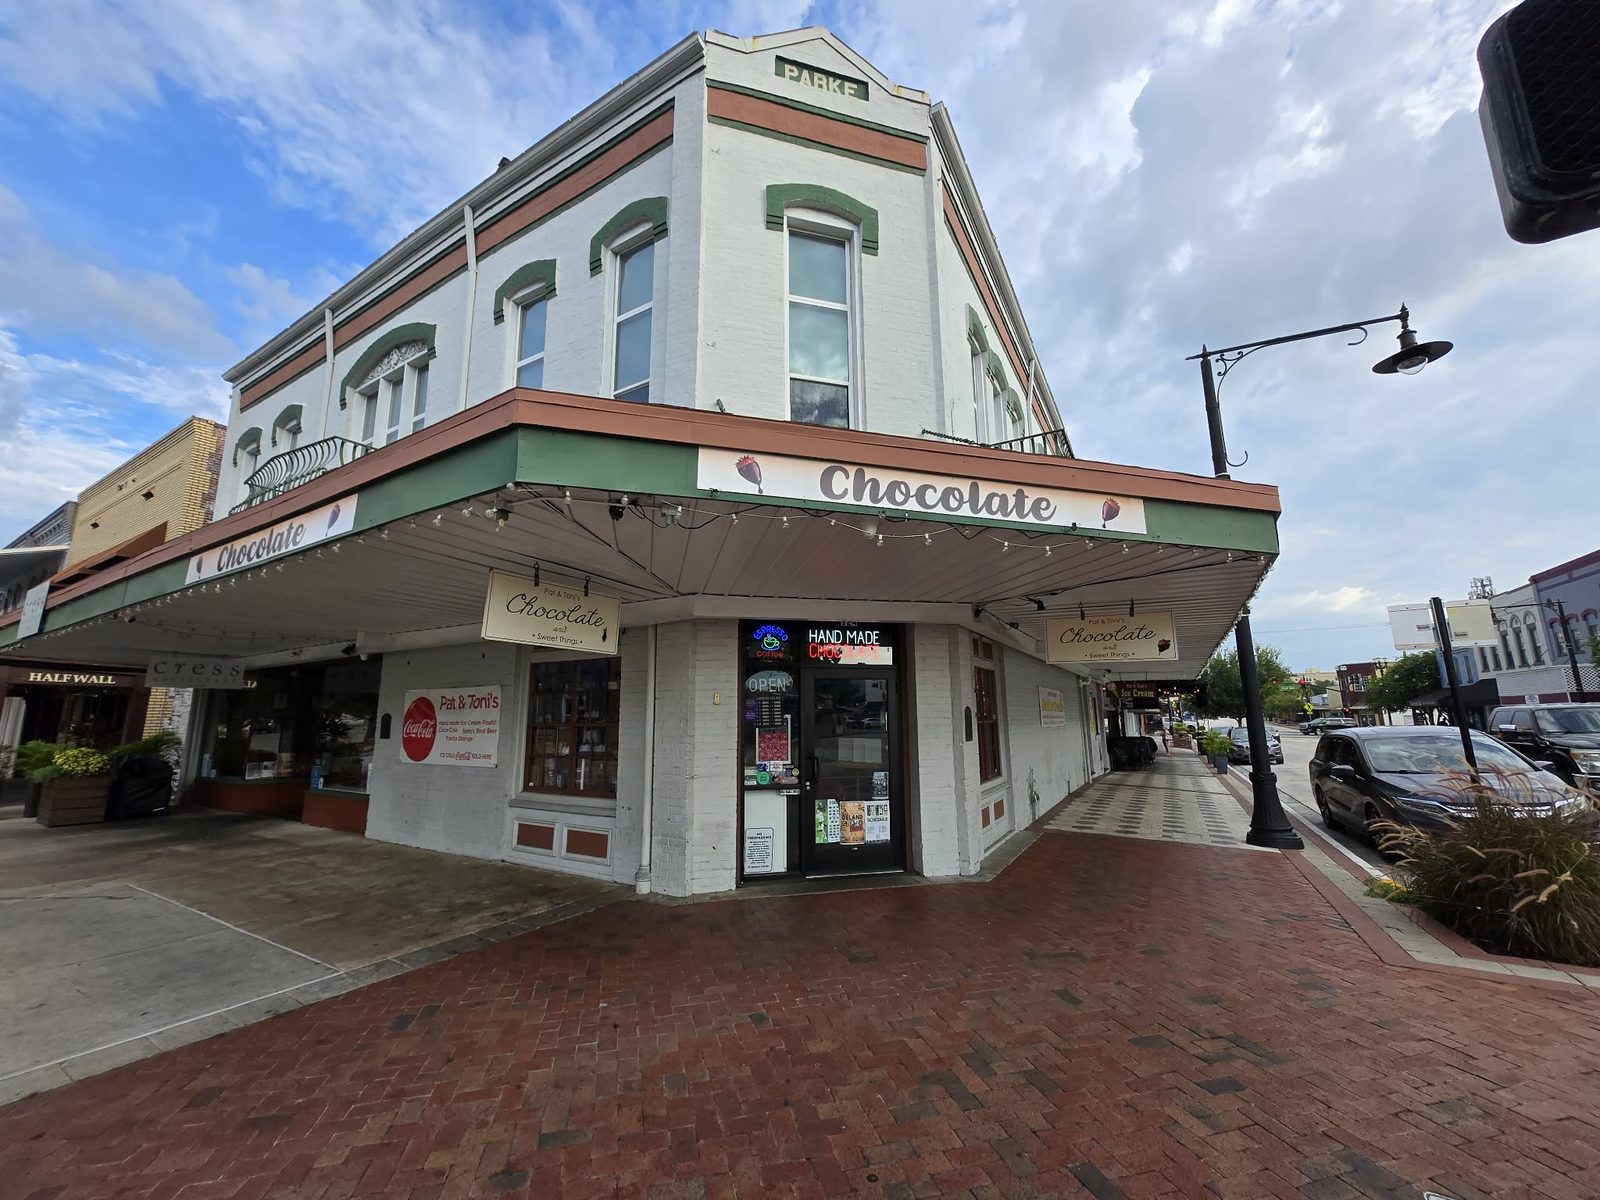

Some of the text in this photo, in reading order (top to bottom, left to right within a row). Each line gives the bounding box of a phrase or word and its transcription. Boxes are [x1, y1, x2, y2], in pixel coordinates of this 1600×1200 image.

[784, 63, 858, 97] PARKE
[819, 464, 1057, 522] Chocolate
[216, 522, 307, 573] Chocolate
[544, 587, 556, 597] Pat
[563, 591, 580, 602] Toni's
[506, 593, 606, 627] Chocolate
[552, 626, 568, 634] and
[753, 625, 788, 642] ESPRESSO
[808, 629, 880, 645] HAND MADE
[1059, 624, 1157, 644] Chocolate
[537, 633, 579, 645] Sweet Things
[756, 650, 785, 658] Coffee
[1102, 643, 1117, 651] and
[1110, 651, 1130, 659] Things
[749, 678, 786, 693] OPEN
[1121, 688, 1155, 698] Ice Cream
[440, 693, 499, 711] Pat & Toni's
